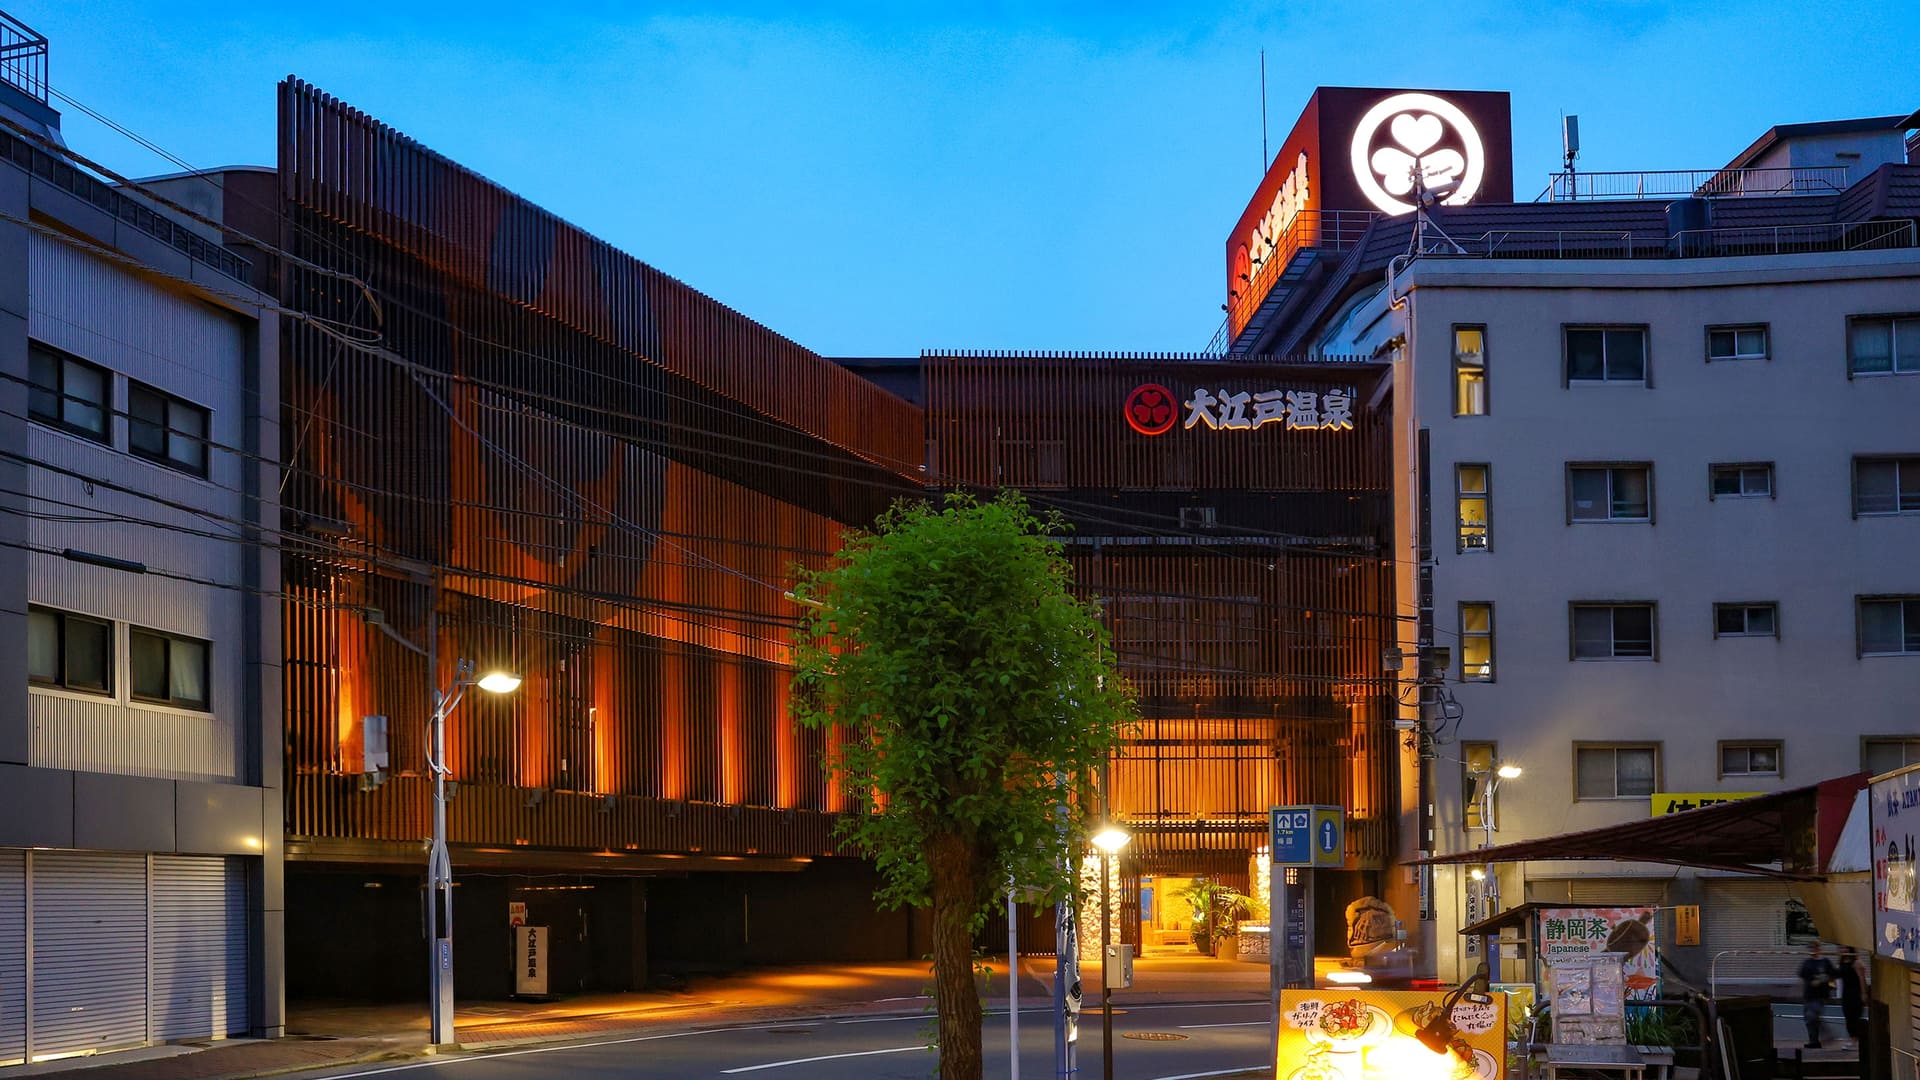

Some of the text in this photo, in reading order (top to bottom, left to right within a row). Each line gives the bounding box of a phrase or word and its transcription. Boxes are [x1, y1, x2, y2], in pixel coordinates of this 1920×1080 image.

[1184, 388, 1353, 431] 大江戸温泉
[1546, 918, 1608, 940] 静岡茶
[528, 928, 536, 978] 大江戸温泉
[1547, 943, 1590, 955] Japanese
